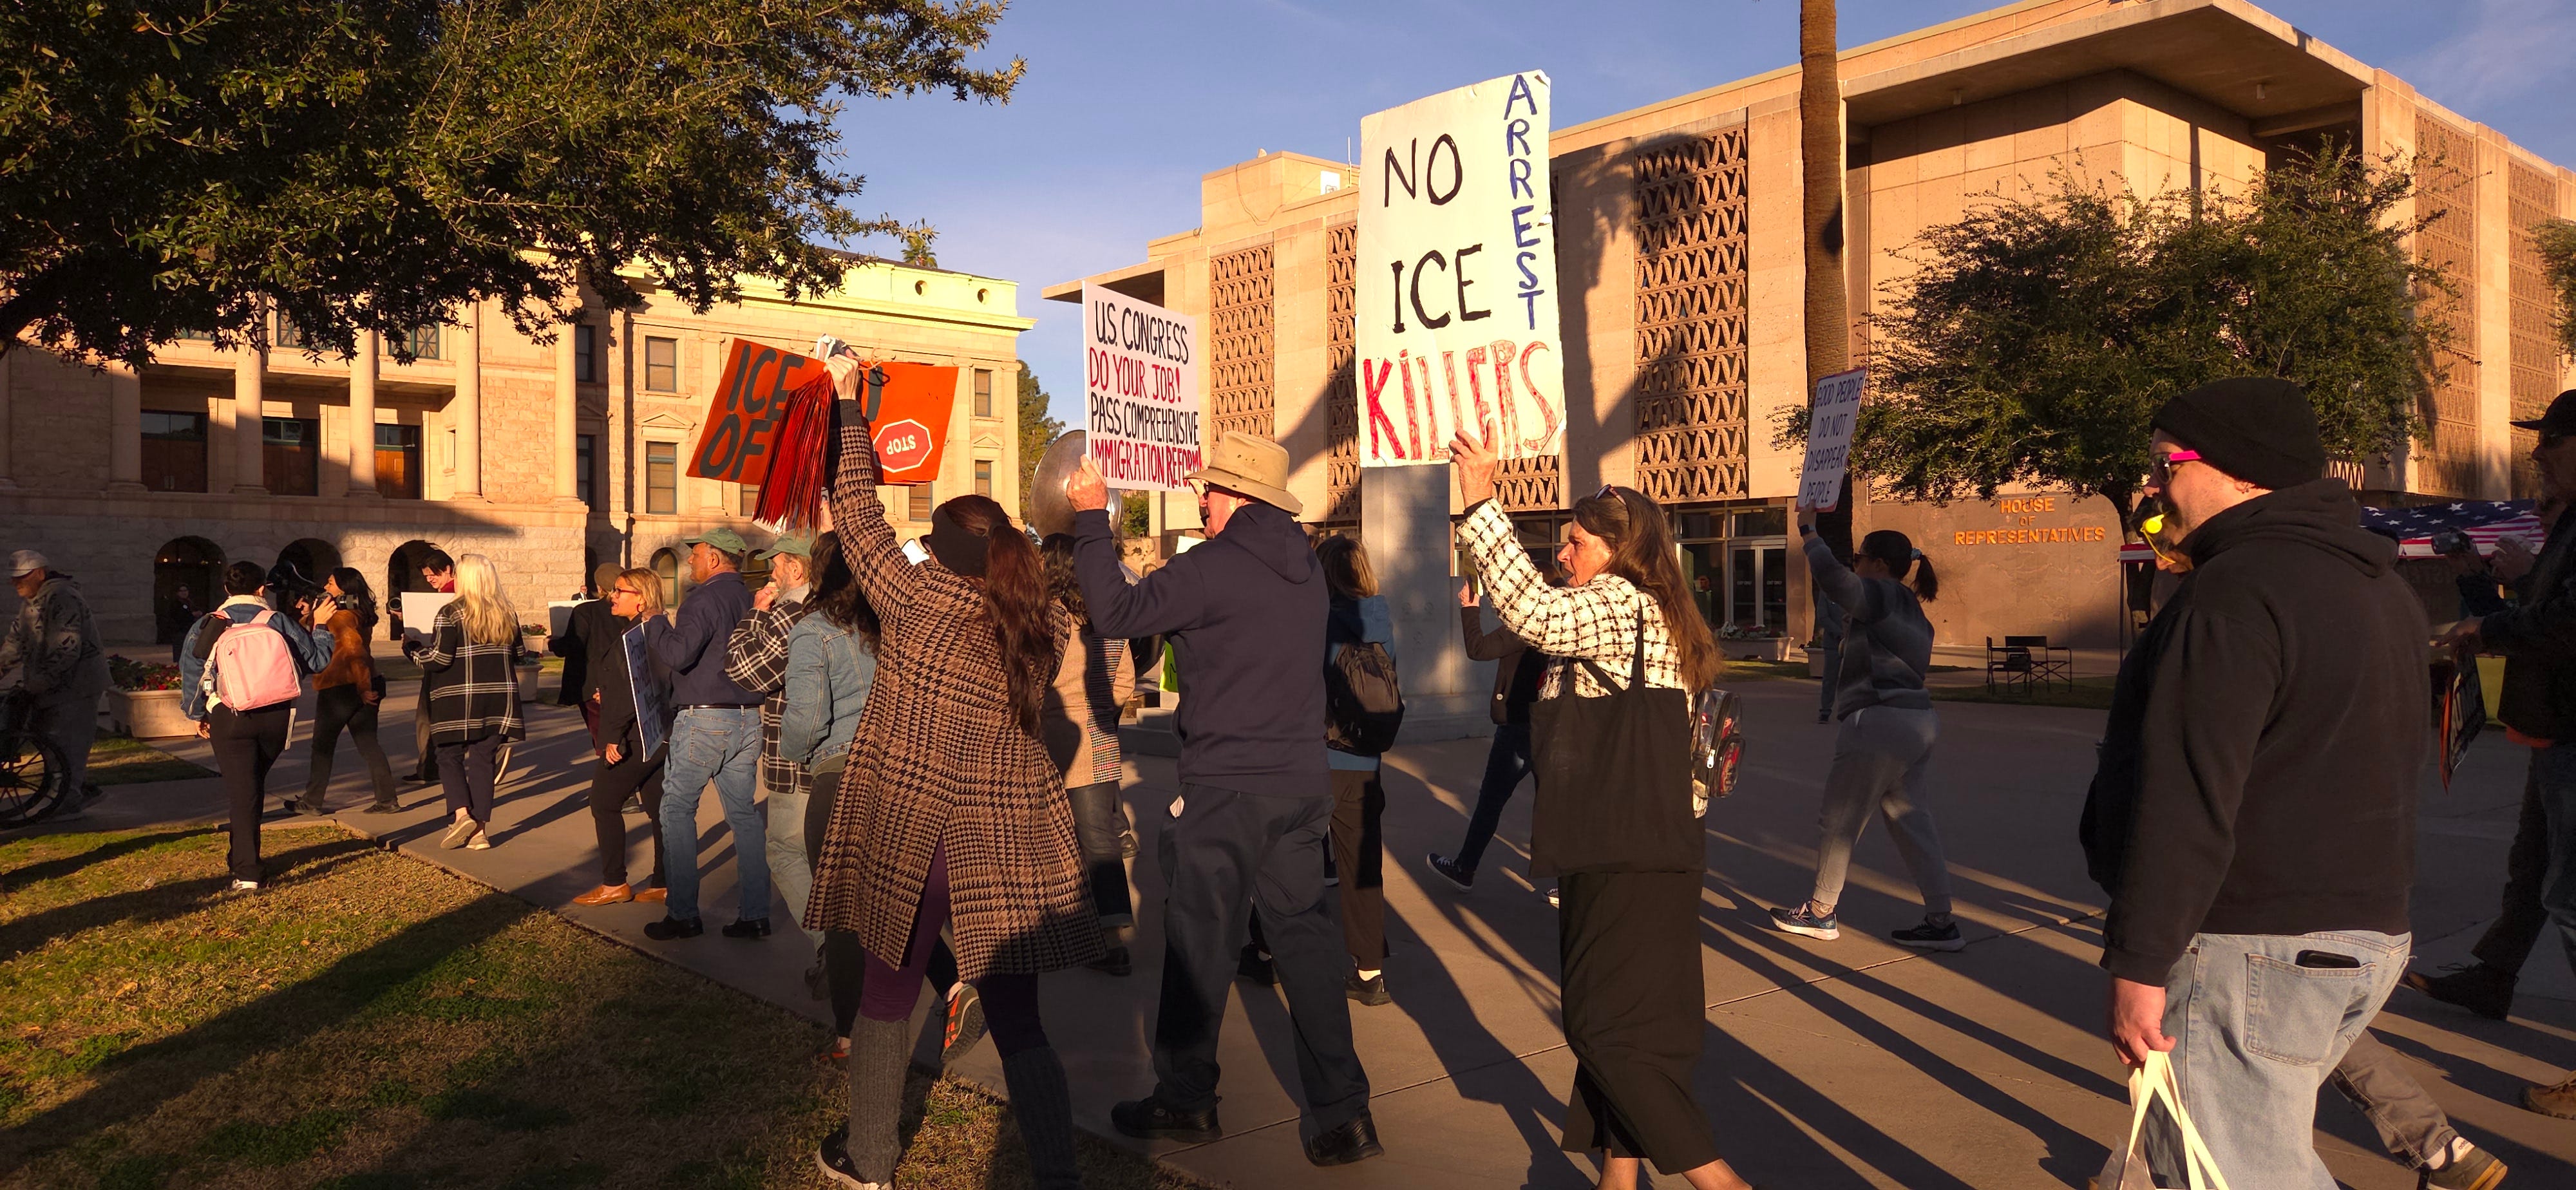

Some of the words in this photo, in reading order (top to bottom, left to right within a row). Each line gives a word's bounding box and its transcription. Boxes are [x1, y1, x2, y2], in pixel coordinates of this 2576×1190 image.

[1385, 133, 1463, 207] NO
[1504, 74, 1544, 330] ARREST
[1390, 243, 1491, 334] ICE
[1095, 300, 1118, 346] U.S.
[1122, 307, 1188, 364] CONGRESS
[726, 344, 804, 419] ICE
[1090, 347, 1109, 391] DO
[1113, 354, 1148, 399] YOUR
[1151, 364, 1181, 404] JOB!
[1816, 382, 1835, 408] GOOD
[1835, 376, 1863, 404] PEOPLE
[1091, 392, 1122, 435] PASS
[1124, 401, 1200, 446] COMPREHENSIVE
[1363, 339, 1557, 460] KILLERS
[886, 435, 916, 455] STOP
[1819, 415, 1830, 438] DO
[1830, 413, 1848, 437] NOT
[1091, 439, 1164, 484] IMMIGRATION
[1807, 444, 1846, 472] DISAPPEAR
[1804, 480, 1832, 504] PEOPLE
[2000, 498, 2055, 514] HOUSE
[1954, 526, 2105, 545] REPRESENTATIVES
[2020, 516, 2036, 526] OF
